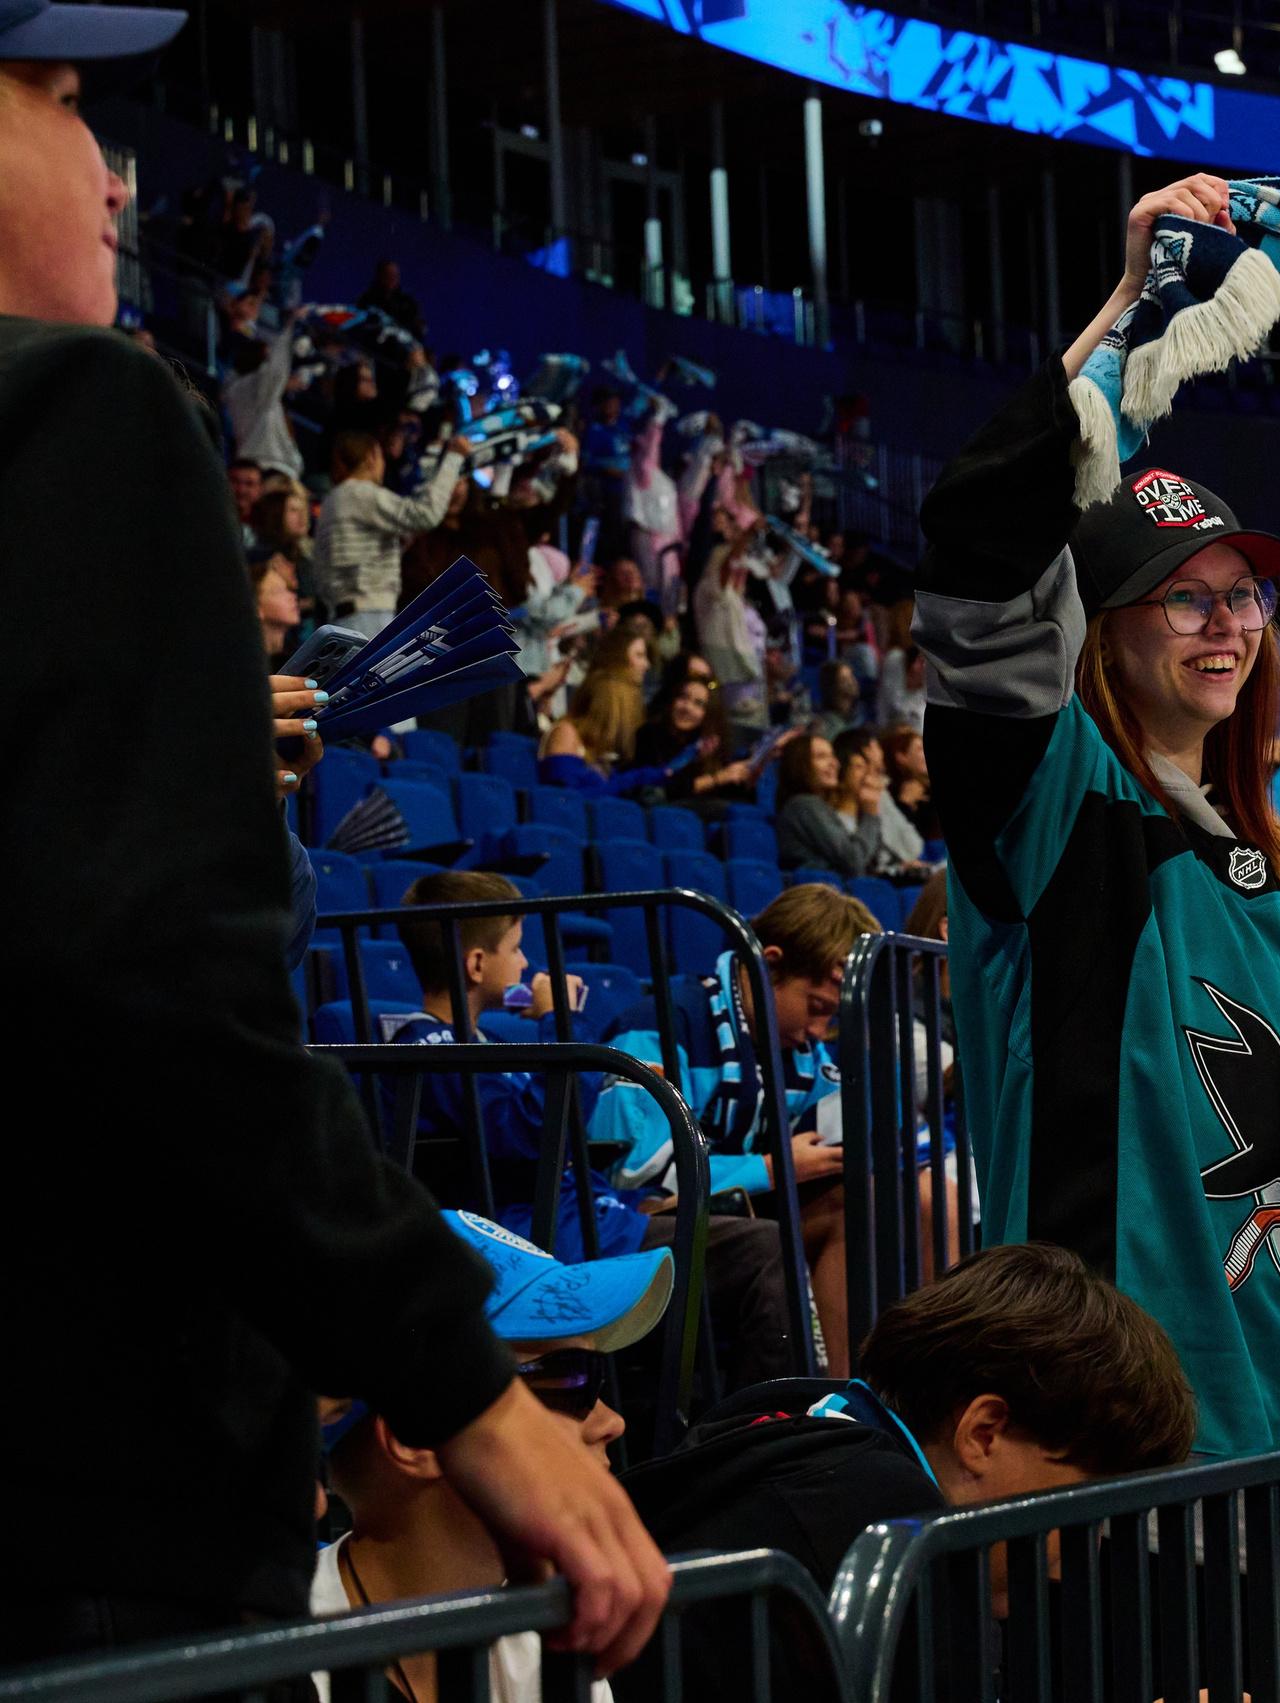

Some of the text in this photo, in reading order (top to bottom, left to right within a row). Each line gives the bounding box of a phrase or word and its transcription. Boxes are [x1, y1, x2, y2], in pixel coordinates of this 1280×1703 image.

[1136, 478, 1194, 506] OVER
[1145, 499, 1206, 522] TIME
[1238, 861, 1258, 879] NHL
